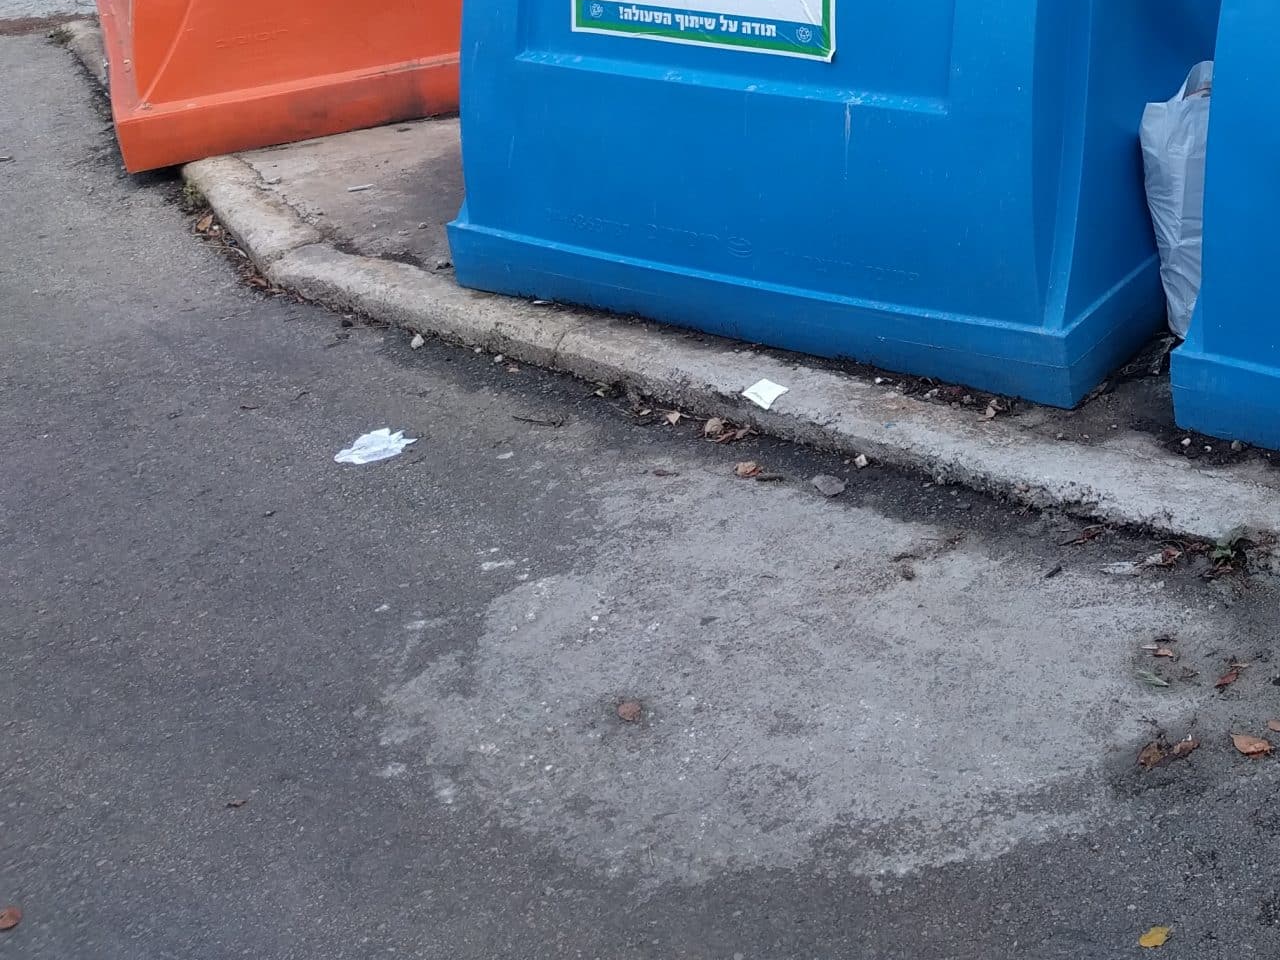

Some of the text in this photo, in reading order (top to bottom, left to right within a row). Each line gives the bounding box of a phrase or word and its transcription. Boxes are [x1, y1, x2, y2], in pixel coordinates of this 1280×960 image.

[619, 4, 671, 25] הפעולה!
[675, 13, 716, 31] שיתוף
[720, 15, 738, 33] על
[742, 21, 776, 37] תודה
